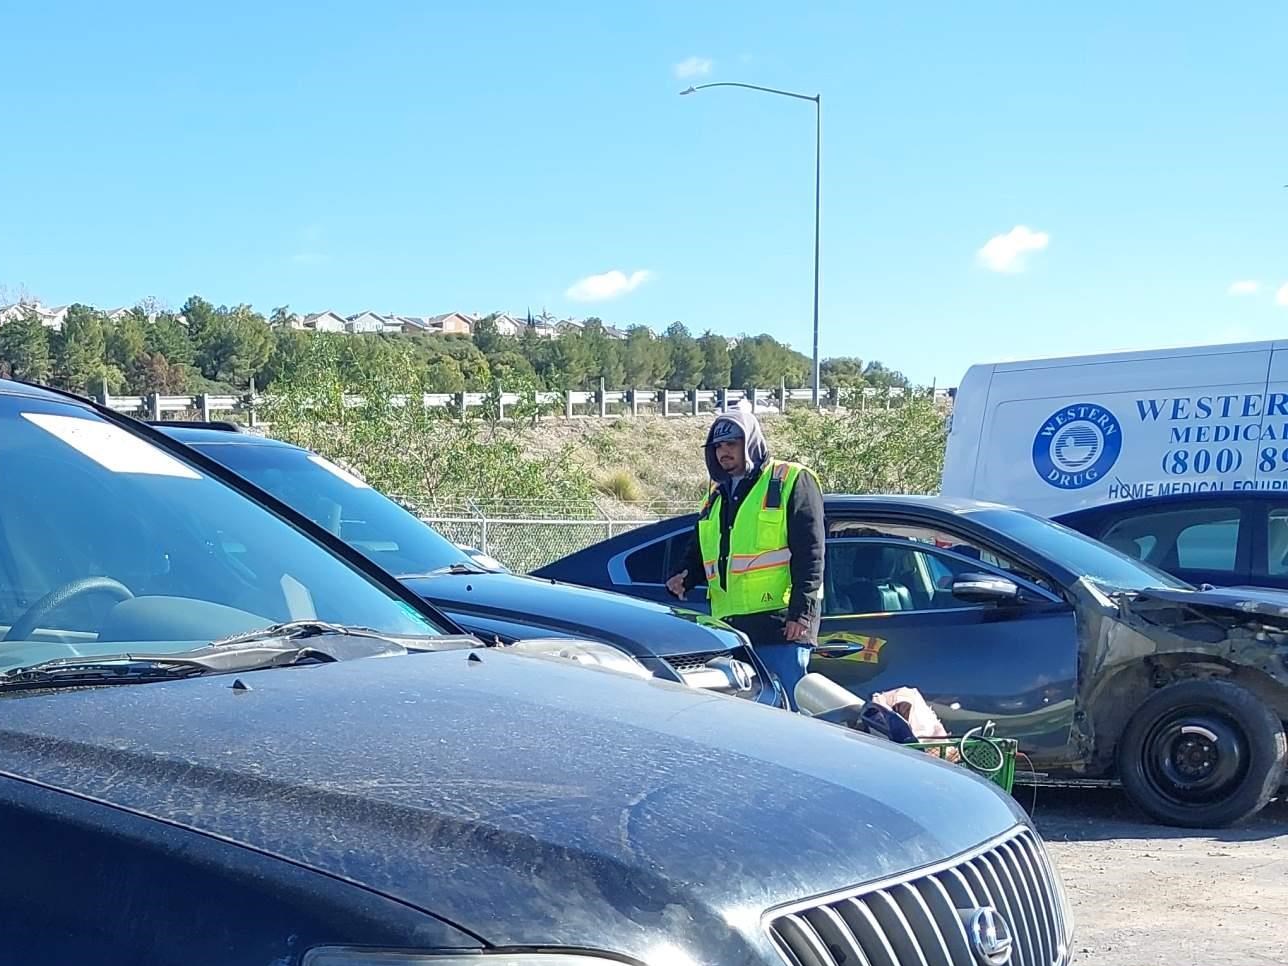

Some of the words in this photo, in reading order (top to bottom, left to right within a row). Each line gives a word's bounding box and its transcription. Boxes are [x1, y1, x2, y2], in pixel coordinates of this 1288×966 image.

[1040, 406, 1117, 437] WESTERN
[1161, 447, 1243, 475] (800)
[1047, 467, 1099, 486] DRUG
[1108, 482, 1154, 499] HOME
